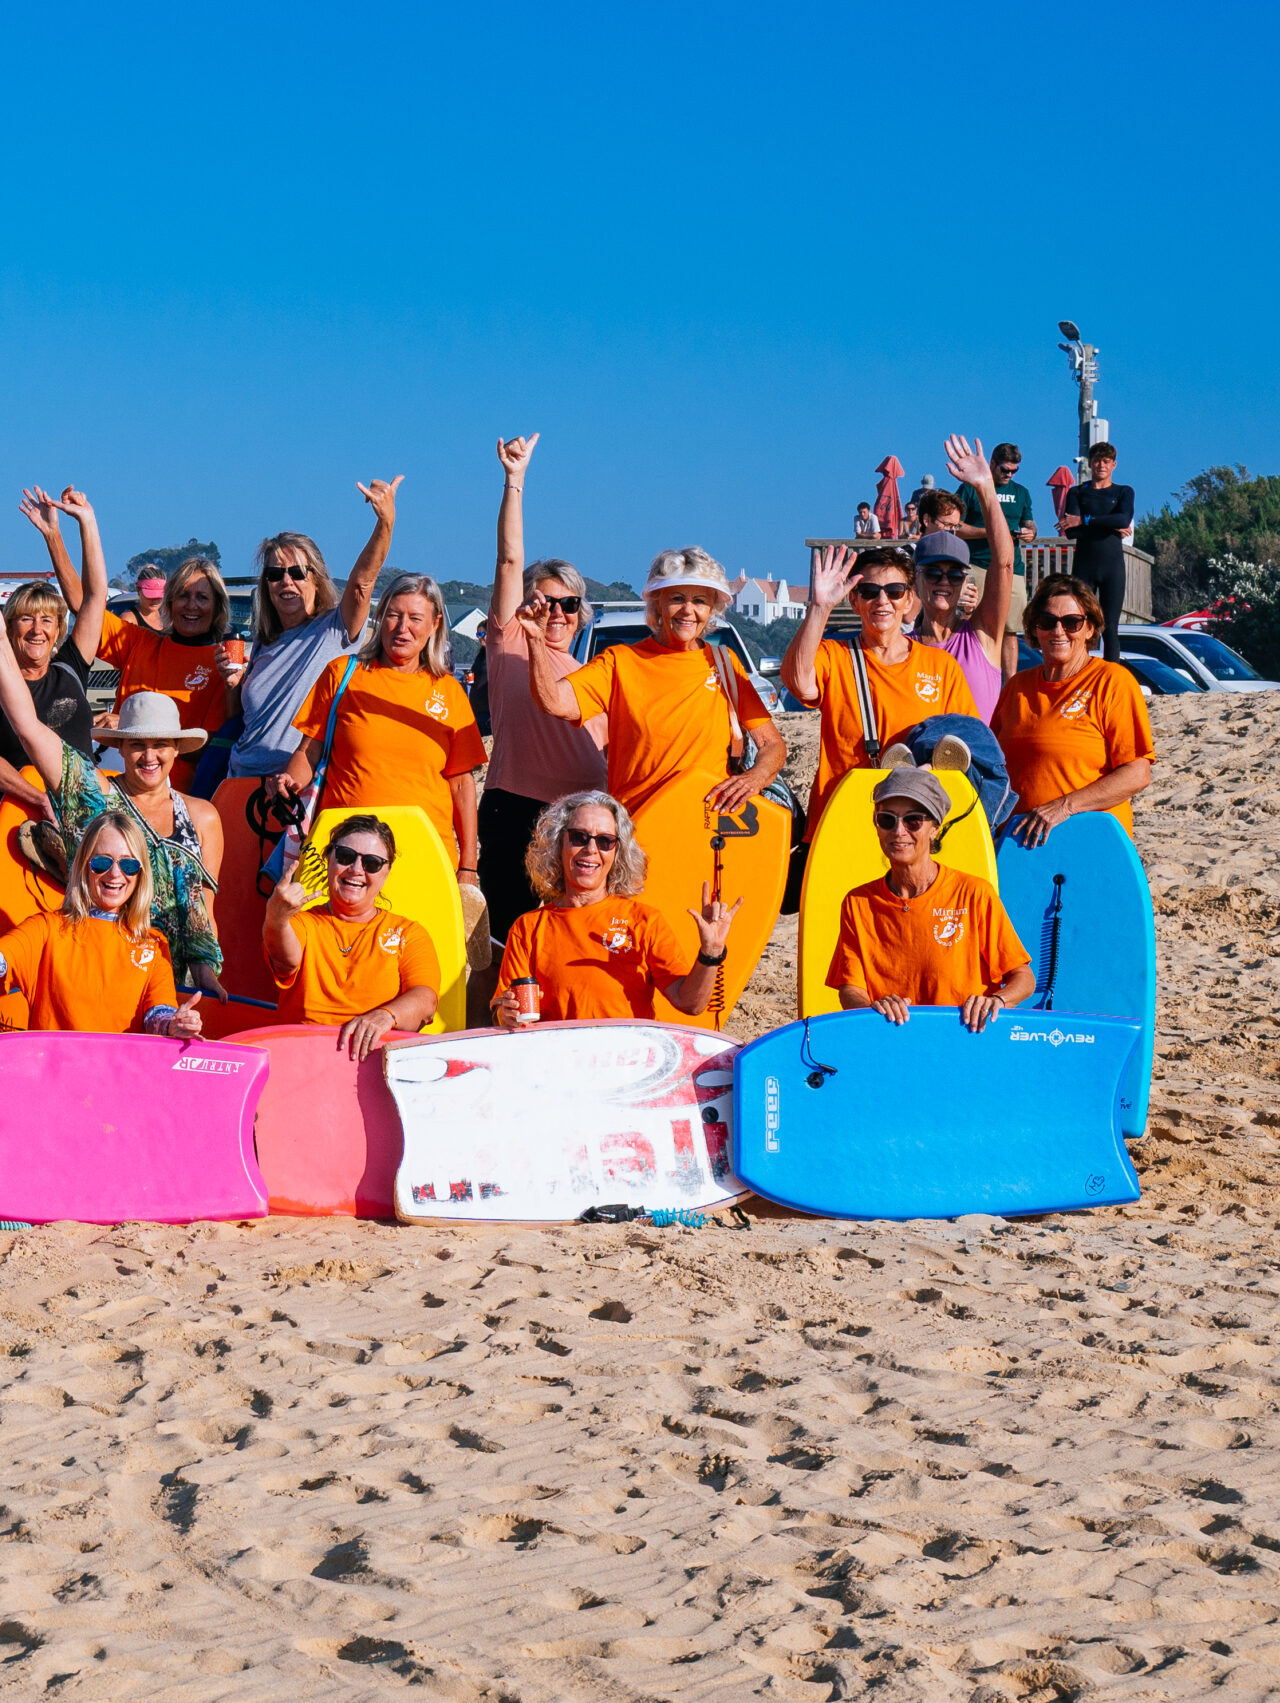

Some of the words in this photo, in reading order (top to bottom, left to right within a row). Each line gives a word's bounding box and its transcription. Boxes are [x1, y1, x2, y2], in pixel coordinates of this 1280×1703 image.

[703, 801, 711, 829] RAPTO
[932, 907, 968, 917] Miriam
[1010, 1030, 1095, 1046] REVOLVER
